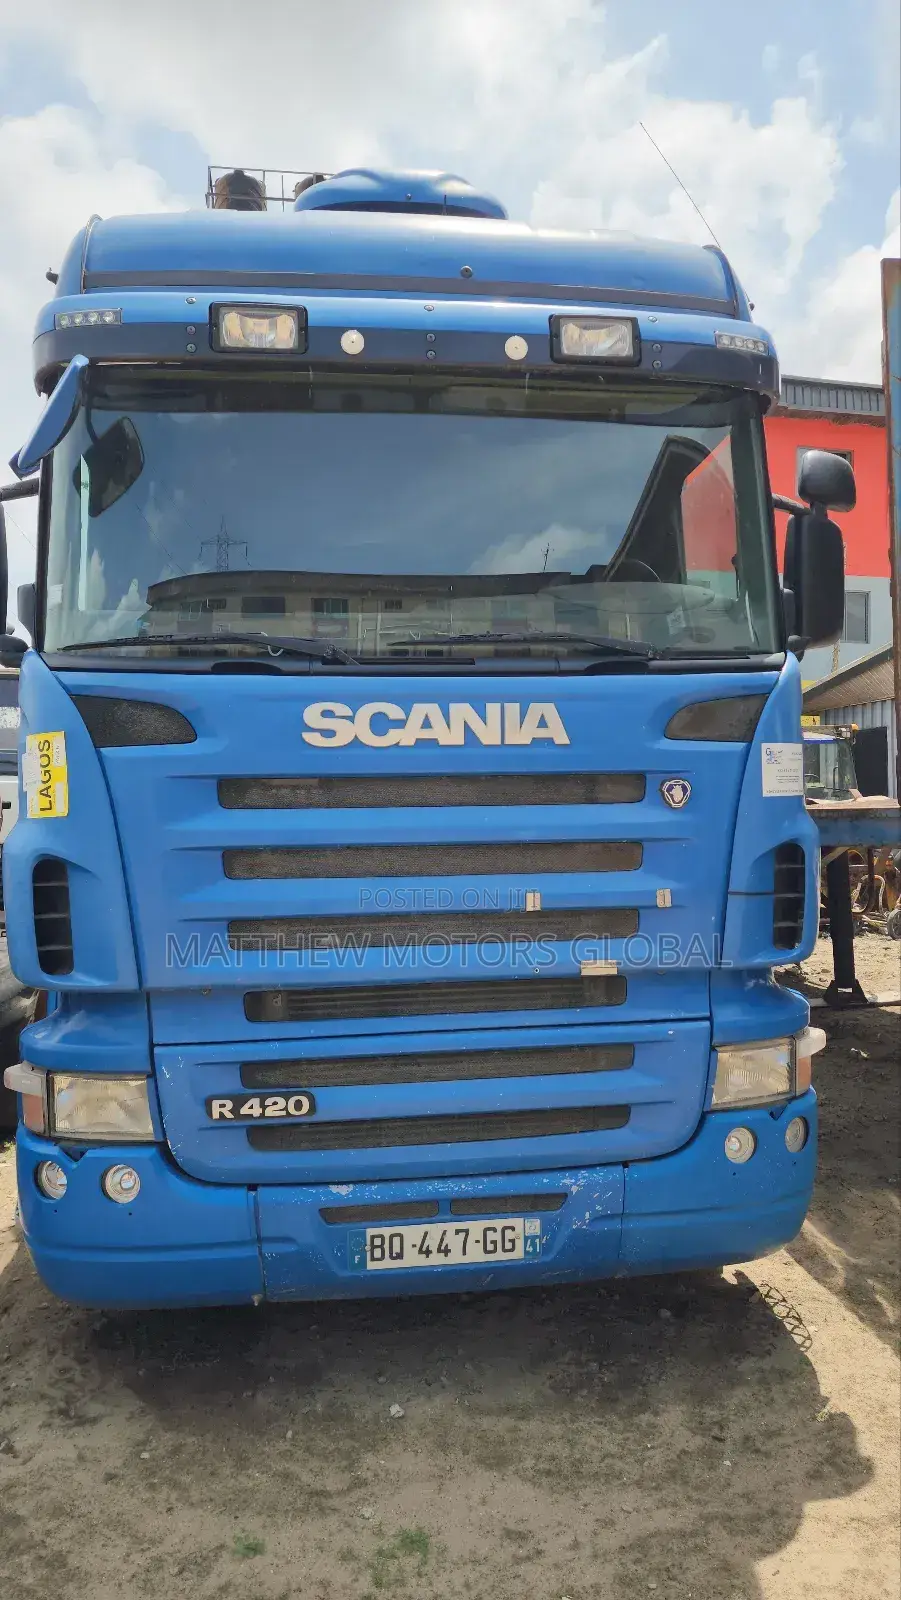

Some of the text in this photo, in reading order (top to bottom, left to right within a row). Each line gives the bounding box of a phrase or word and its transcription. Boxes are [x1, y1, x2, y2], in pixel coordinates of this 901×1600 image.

[302, 701, 570, 747] SCANIA
[38, 739, 53, 812] LAGOS
[211, 1095, 310, 1120] R 420
[370, 1225, 516, 1262] BQ-447-GG
[525, 1238, 540, 1253] 41
[354, 1255, 361, 1264] F
